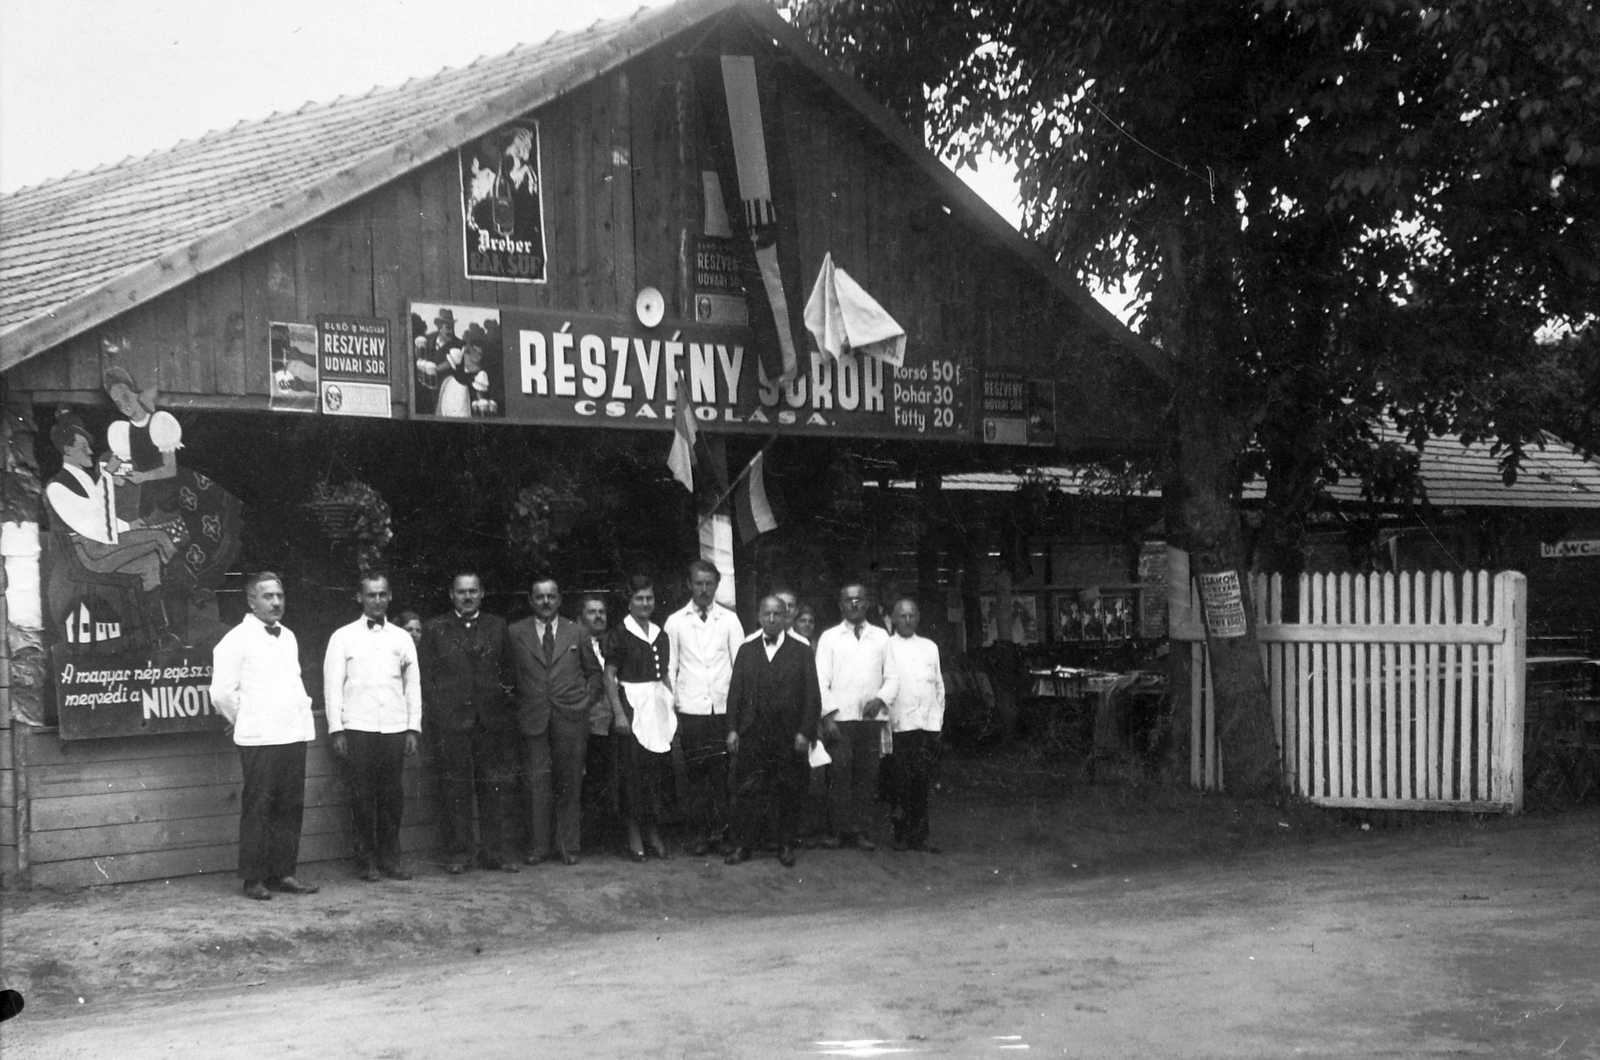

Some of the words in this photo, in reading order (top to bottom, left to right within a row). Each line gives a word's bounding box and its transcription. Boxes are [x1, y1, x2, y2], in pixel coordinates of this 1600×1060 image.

[477, 229, 532, 255] Dreher
[359, 325, 385, 334] MAGYAR
[324, 331, 385, 357] RÉSZVÉNY
[324, 356, 362, 373] UDVARI
[365, 357, 386, 374] SÖR
[519, 322, 744, 404] RÉSZVÉNY
[893, 364, 928, 381] Korsó
[932, 359, 954, 382] 50
[893, 382, 932, 404] Pohár
[933, 385, 954, 405] 30
[894, 406, 926, 433] Fütty
[933, 407, 954, 428] 20
[61, 663, 75, 684] A
[76, 668, 132, 687] magyar
[134, 660, 161, 684] nép
[163, 658, 214, 683] egészs
[65, 683, 128, 710] megvédi
[130, 690, 140, 702] a
